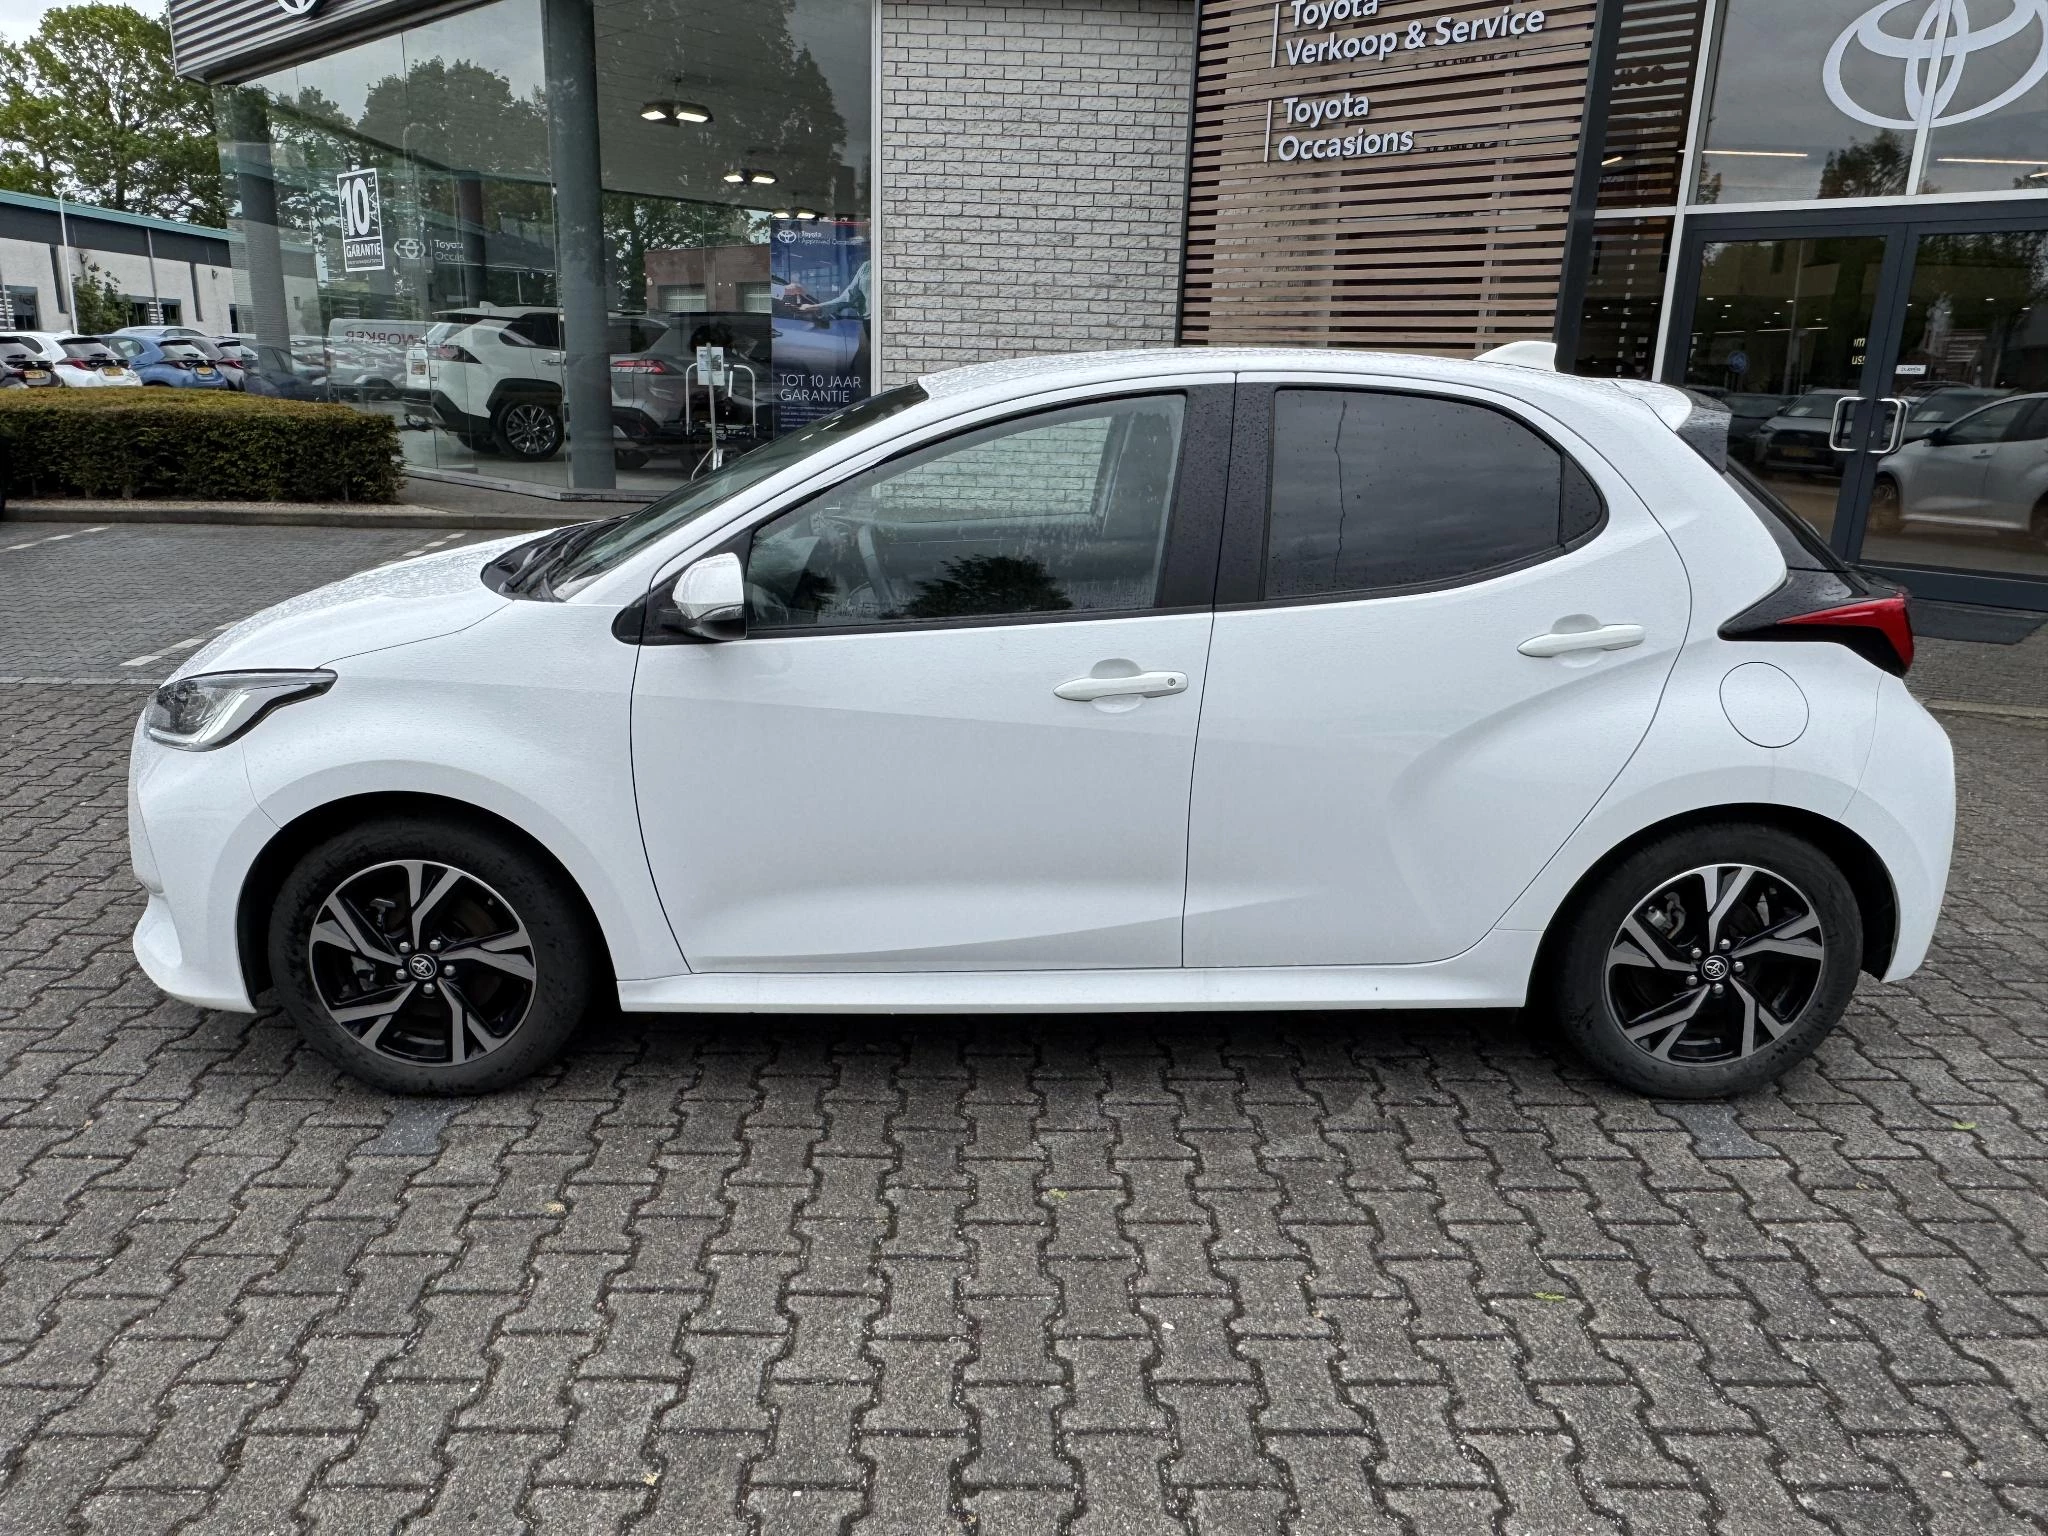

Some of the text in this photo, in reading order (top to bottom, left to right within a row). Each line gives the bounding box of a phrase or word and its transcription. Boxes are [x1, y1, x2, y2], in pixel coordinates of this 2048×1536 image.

[1291, 0, 1378, 29] Toyota
[1286, 6, 1545, 66] Verkoop & Service
[1283, 92, 1369, 128] Toyota
[1278, 128, 1414, 162] Occasions
[341, 177, 370, 236] 10
[346, 243, 381, 258] GARANTIE
[780, 374, 861, 389] TOT 10 JAAR
[780, 388, 850, 403] GARANTIE
